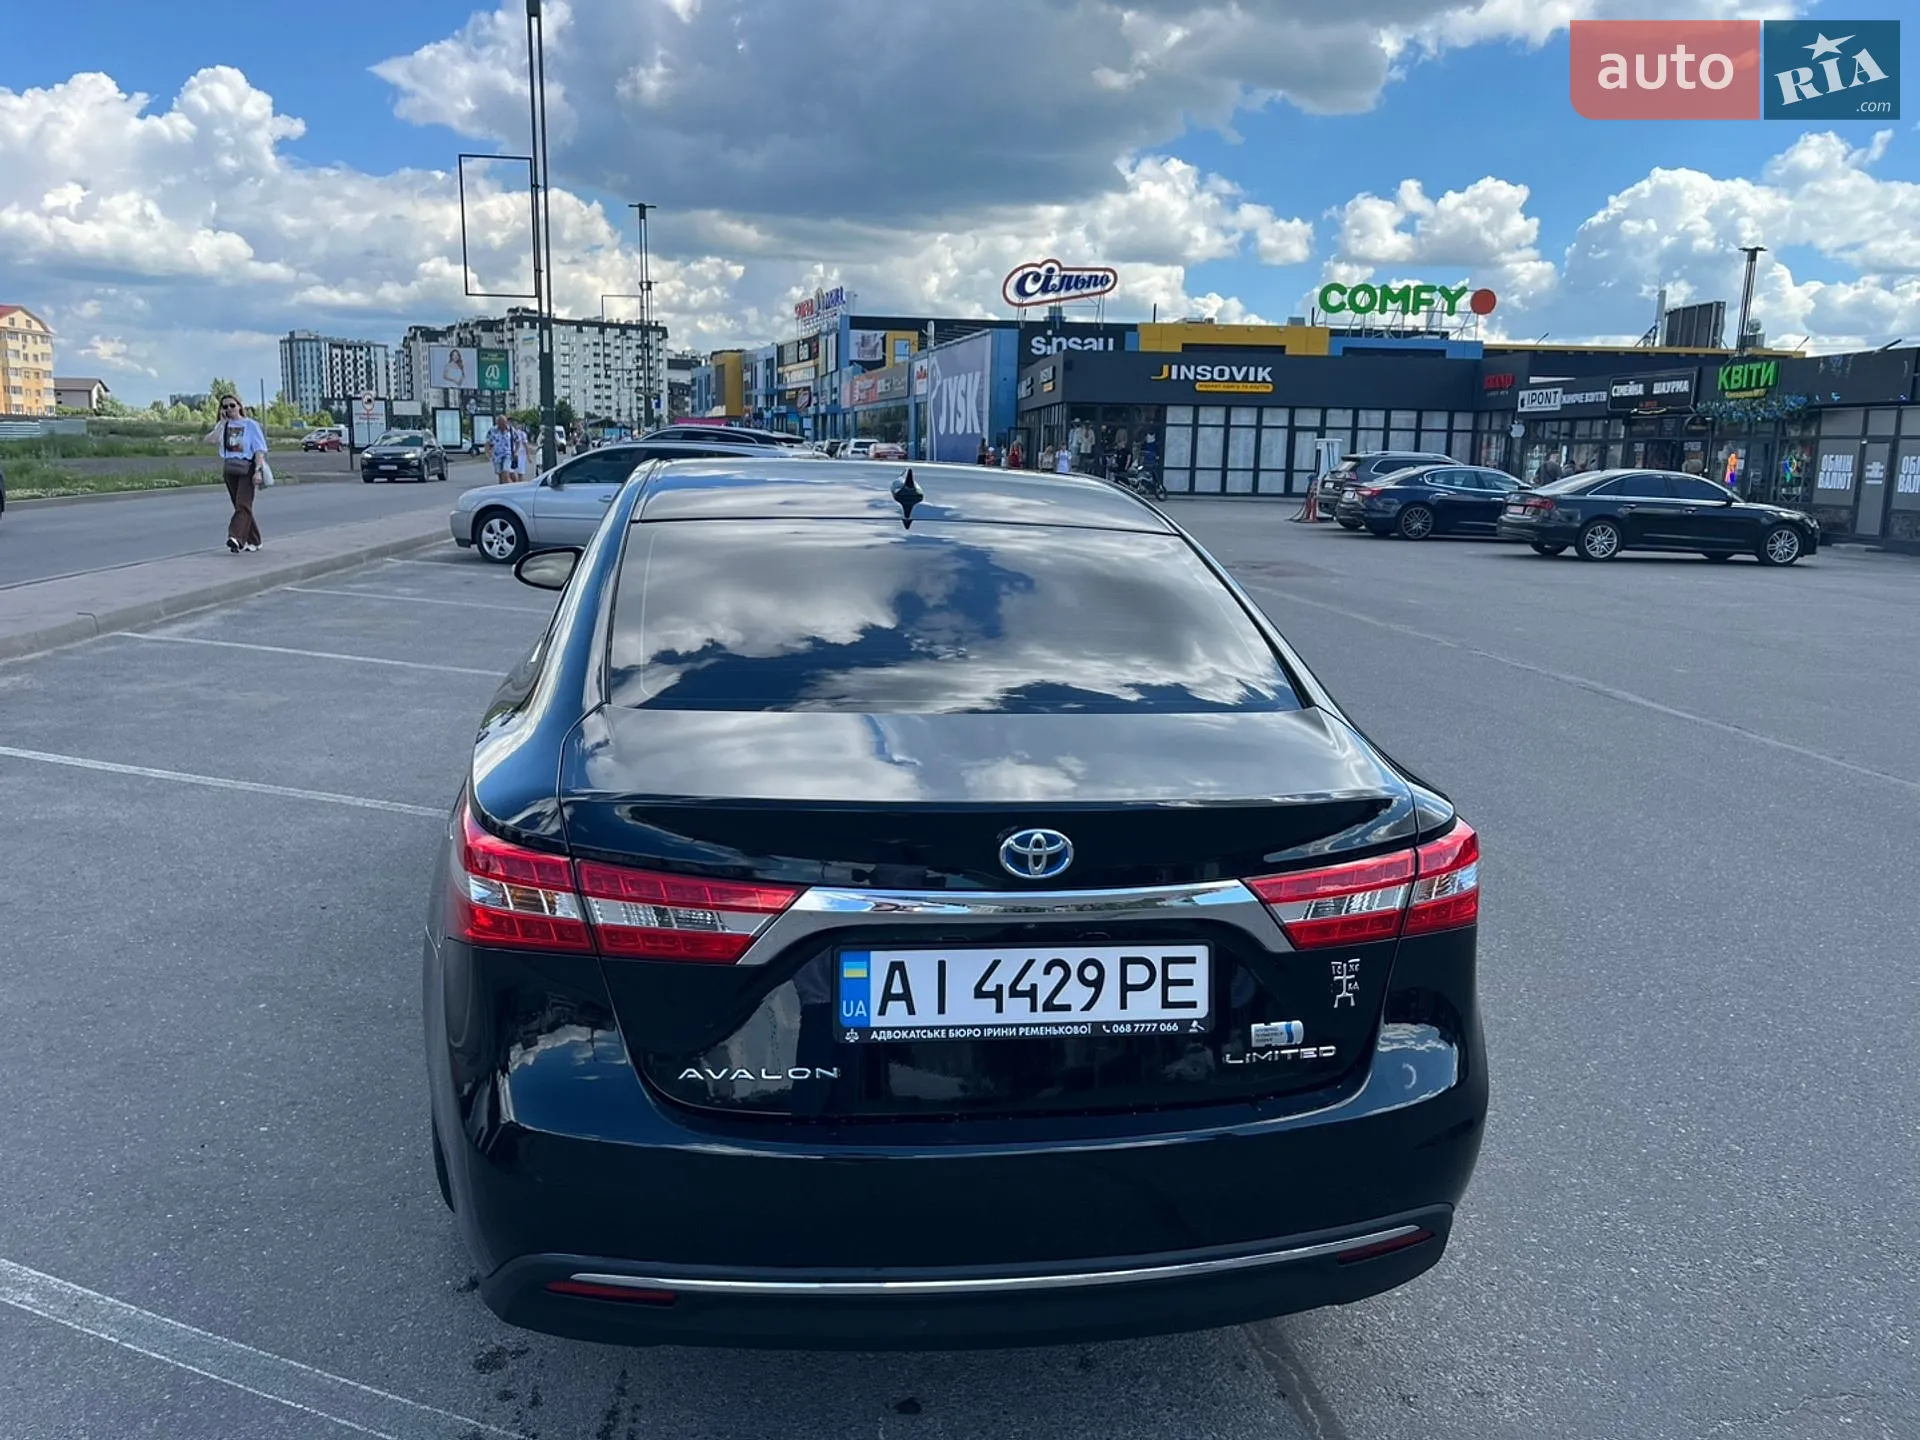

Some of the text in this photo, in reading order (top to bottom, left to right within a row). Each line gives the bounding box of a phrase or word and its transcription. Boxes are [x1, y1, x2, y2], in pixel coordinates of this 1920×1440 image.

[1015, 266, 1112, 298] Сільпо
[1318, 281, 1468, 317] COMFY
[1150, 363, 1273, 382] JINSOVIK
[1717, 360, 1776, 391] КВІТИ
[938, 371, 981, 435] JYSK
[1821, 454, 1854, 472] ОБМІН
[1817, 472, 1853, 490] ВАЛЮТ
[876, 955, 1198, 1017] AI 4429 PE
[842, 1000, 868, 1018] UA
[870, 1022, 1092, 1041] АДВОКАТСЬКЕ БЮРО ІРИНИ РЕМЕНЬКОВОЇ
[1112, 1021, 1179, 1034] 068 7777 066
[1224, 1045, 1336, 1064] LIMITED
[677, 1067, 841, 1080] AVALON
